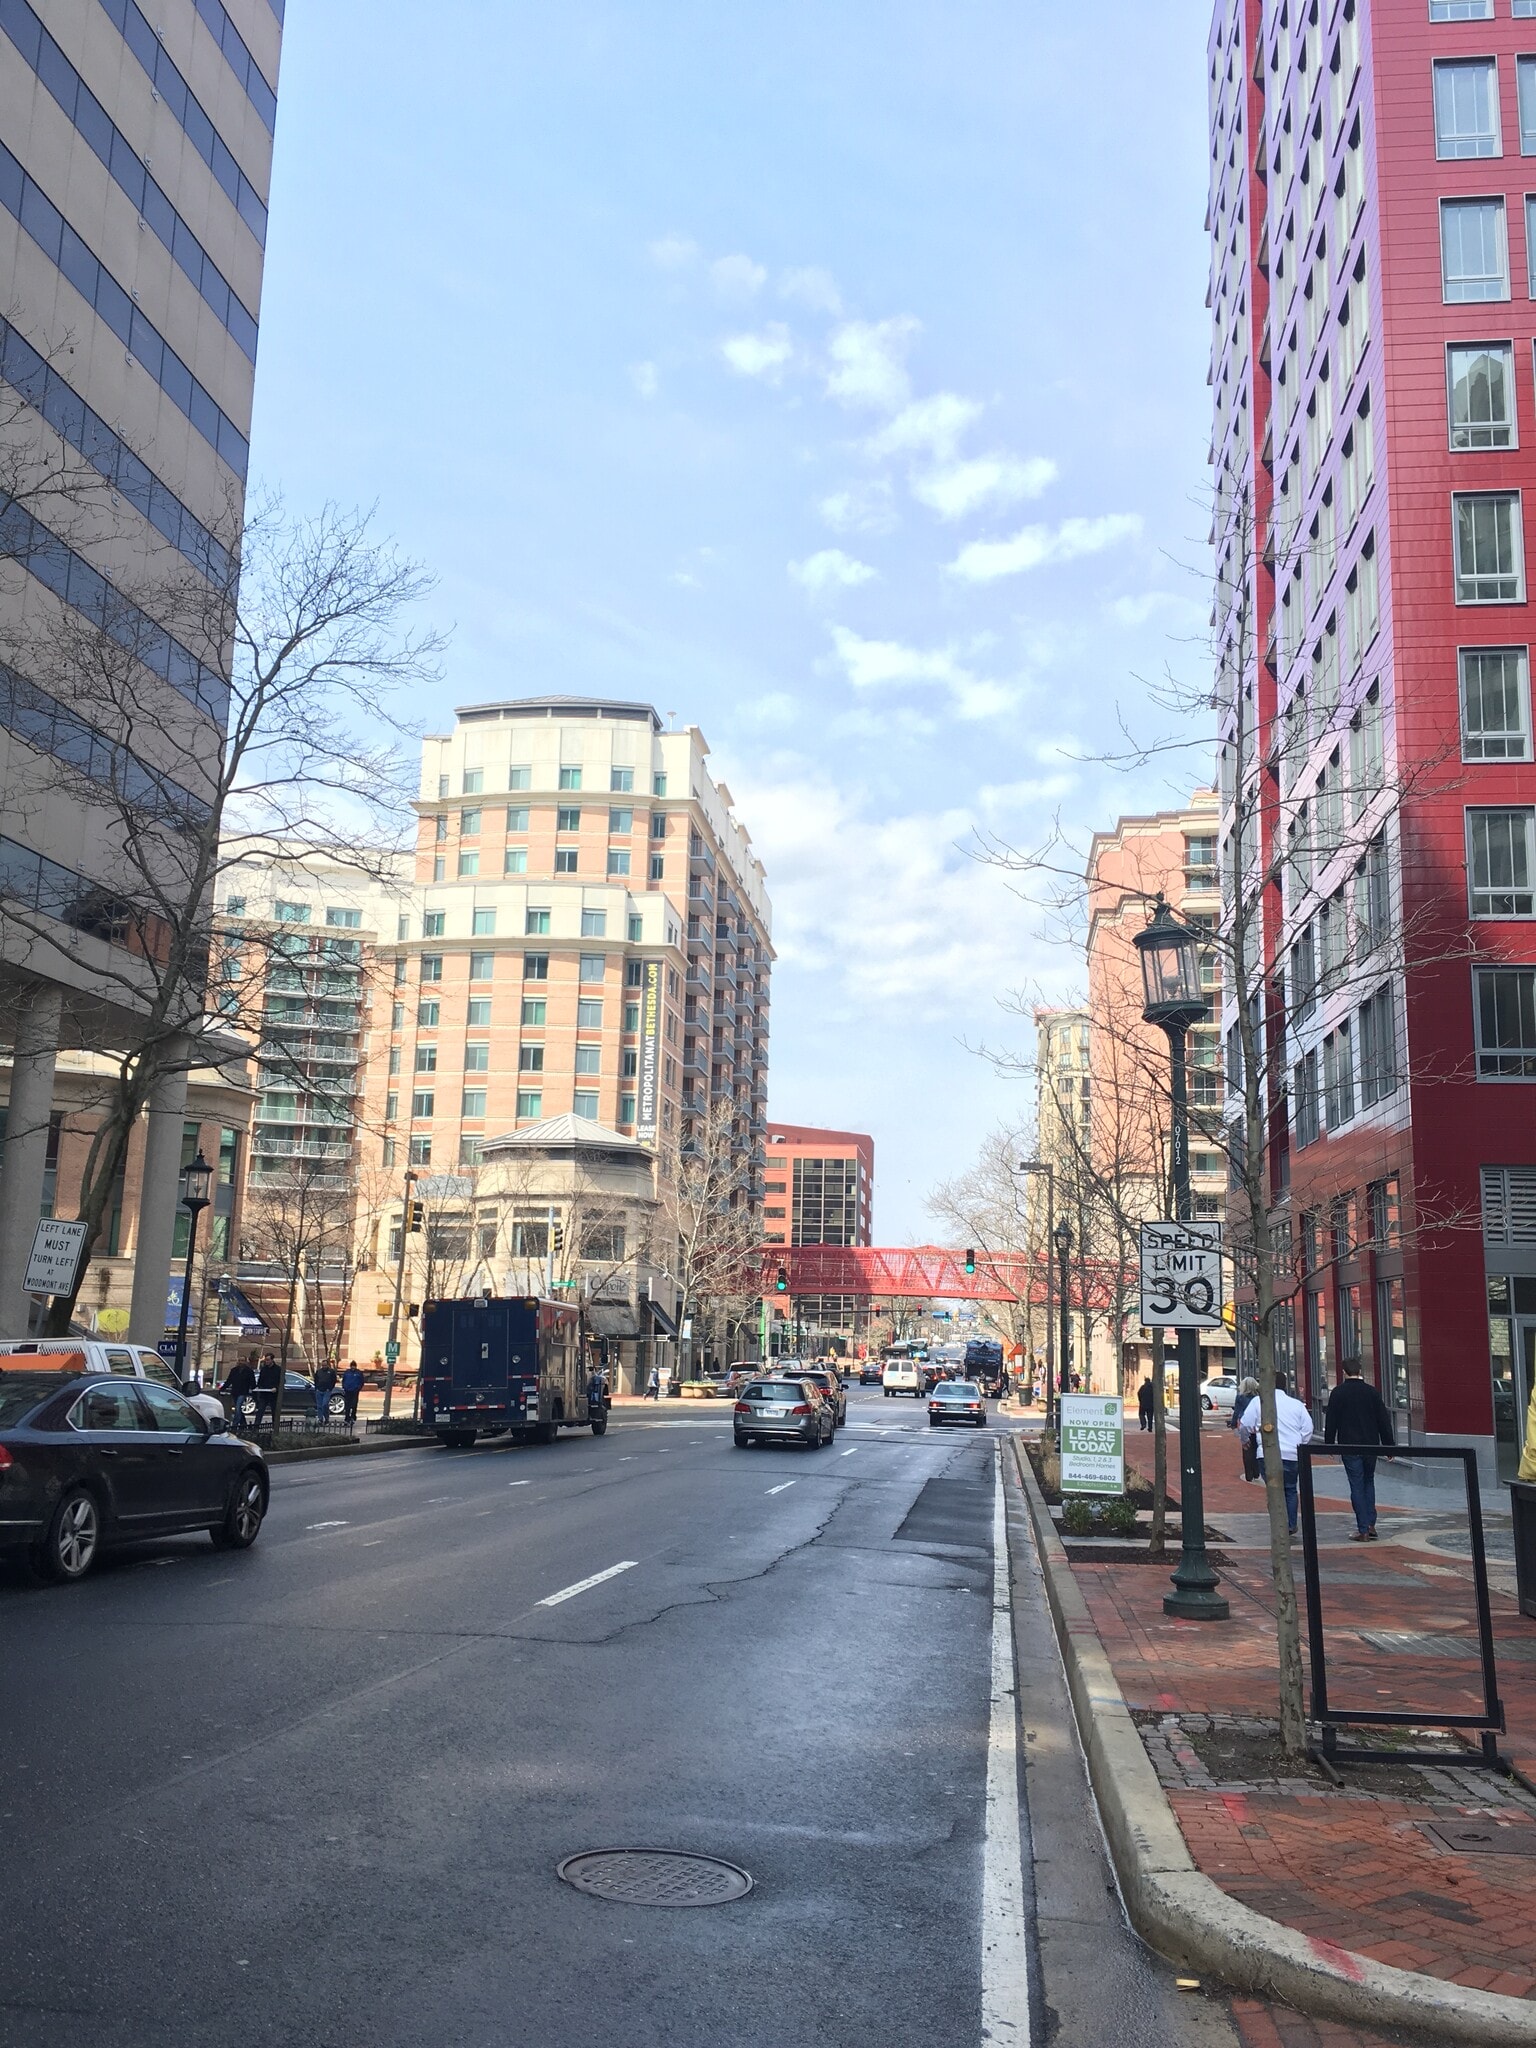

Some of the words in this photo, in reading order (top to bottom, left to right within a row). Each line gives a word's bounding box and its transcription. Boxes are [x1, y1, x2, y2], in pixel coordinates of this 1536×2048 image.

[41, 1224, 60, 1233] LEFT
[62, 1226, 82, 1236] LANE
[44, 1239, 70, 1251] MUST
[1147, 1233, 1214, 1249] SPEED
[33, 1254, 53, 1264] TURN
[55, 1257, 75, 1267] LEFT
[1154, 1255, 1206, 1271] LIMIT
[27, 1277, 58, 1290] WOODMONT
[58, 1282, 70, 1291] AVE
[1148, 1276, 1214, 1315] 30
[388, 1343, 398, 1352] M
[1066, 1405, 1103, 1416] Element
[1069, 1429, 1115, 1442] LEASE
[1069, 1441, 1115, 1453] TODAY
[1068, 1473, 1116, 1481] 844-469-6802
